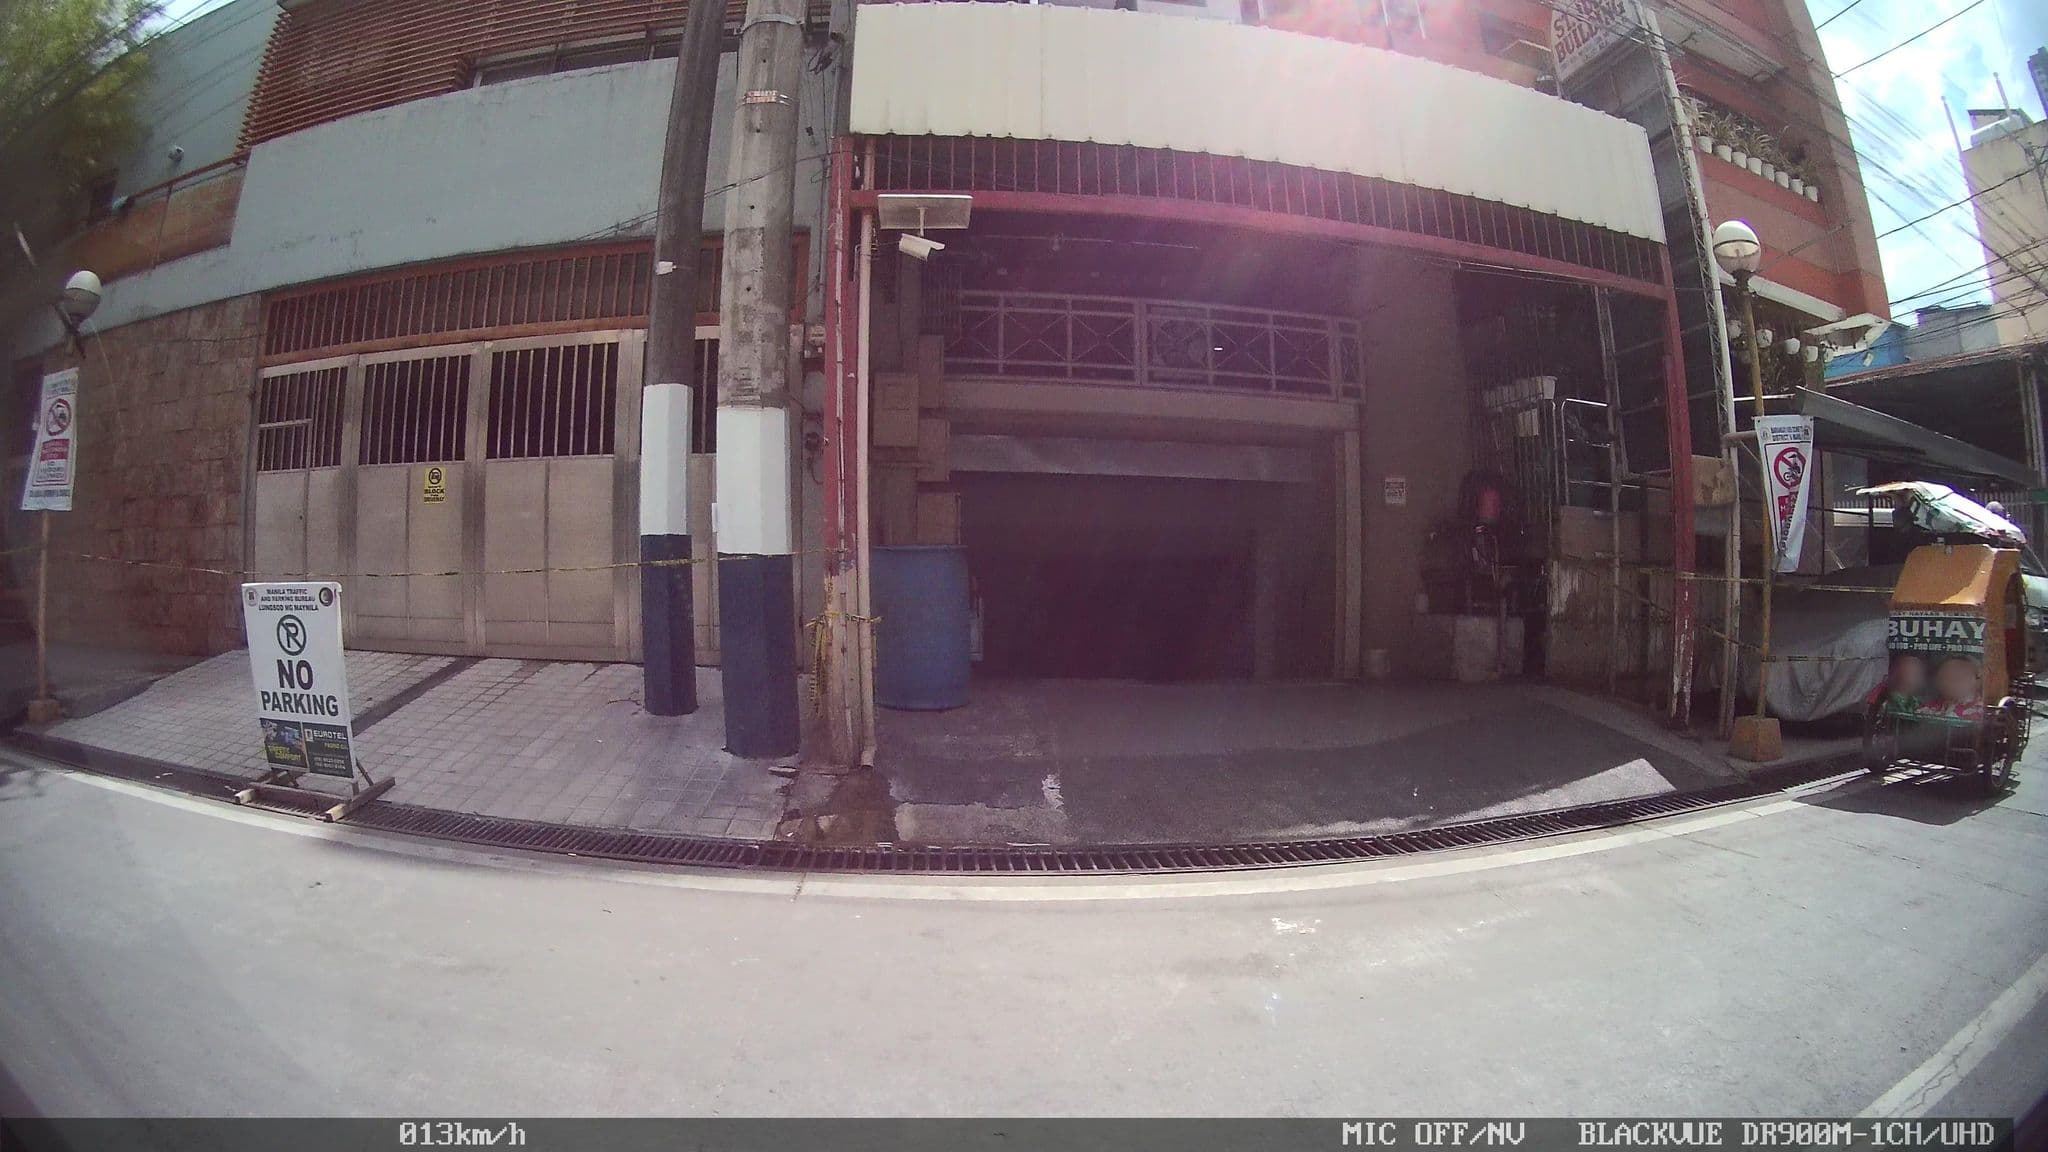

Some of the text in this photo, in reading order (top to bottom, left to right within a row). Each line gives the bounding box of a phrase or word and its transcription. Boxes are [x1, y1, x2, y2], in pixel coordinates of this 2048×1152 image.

[1888, 620, 1987, 639] BUHAY
[277, 659, 314, 690] NO
[260, 690, 339, 717] PARKING
[313, 729, 347, 740] EUROTEL
